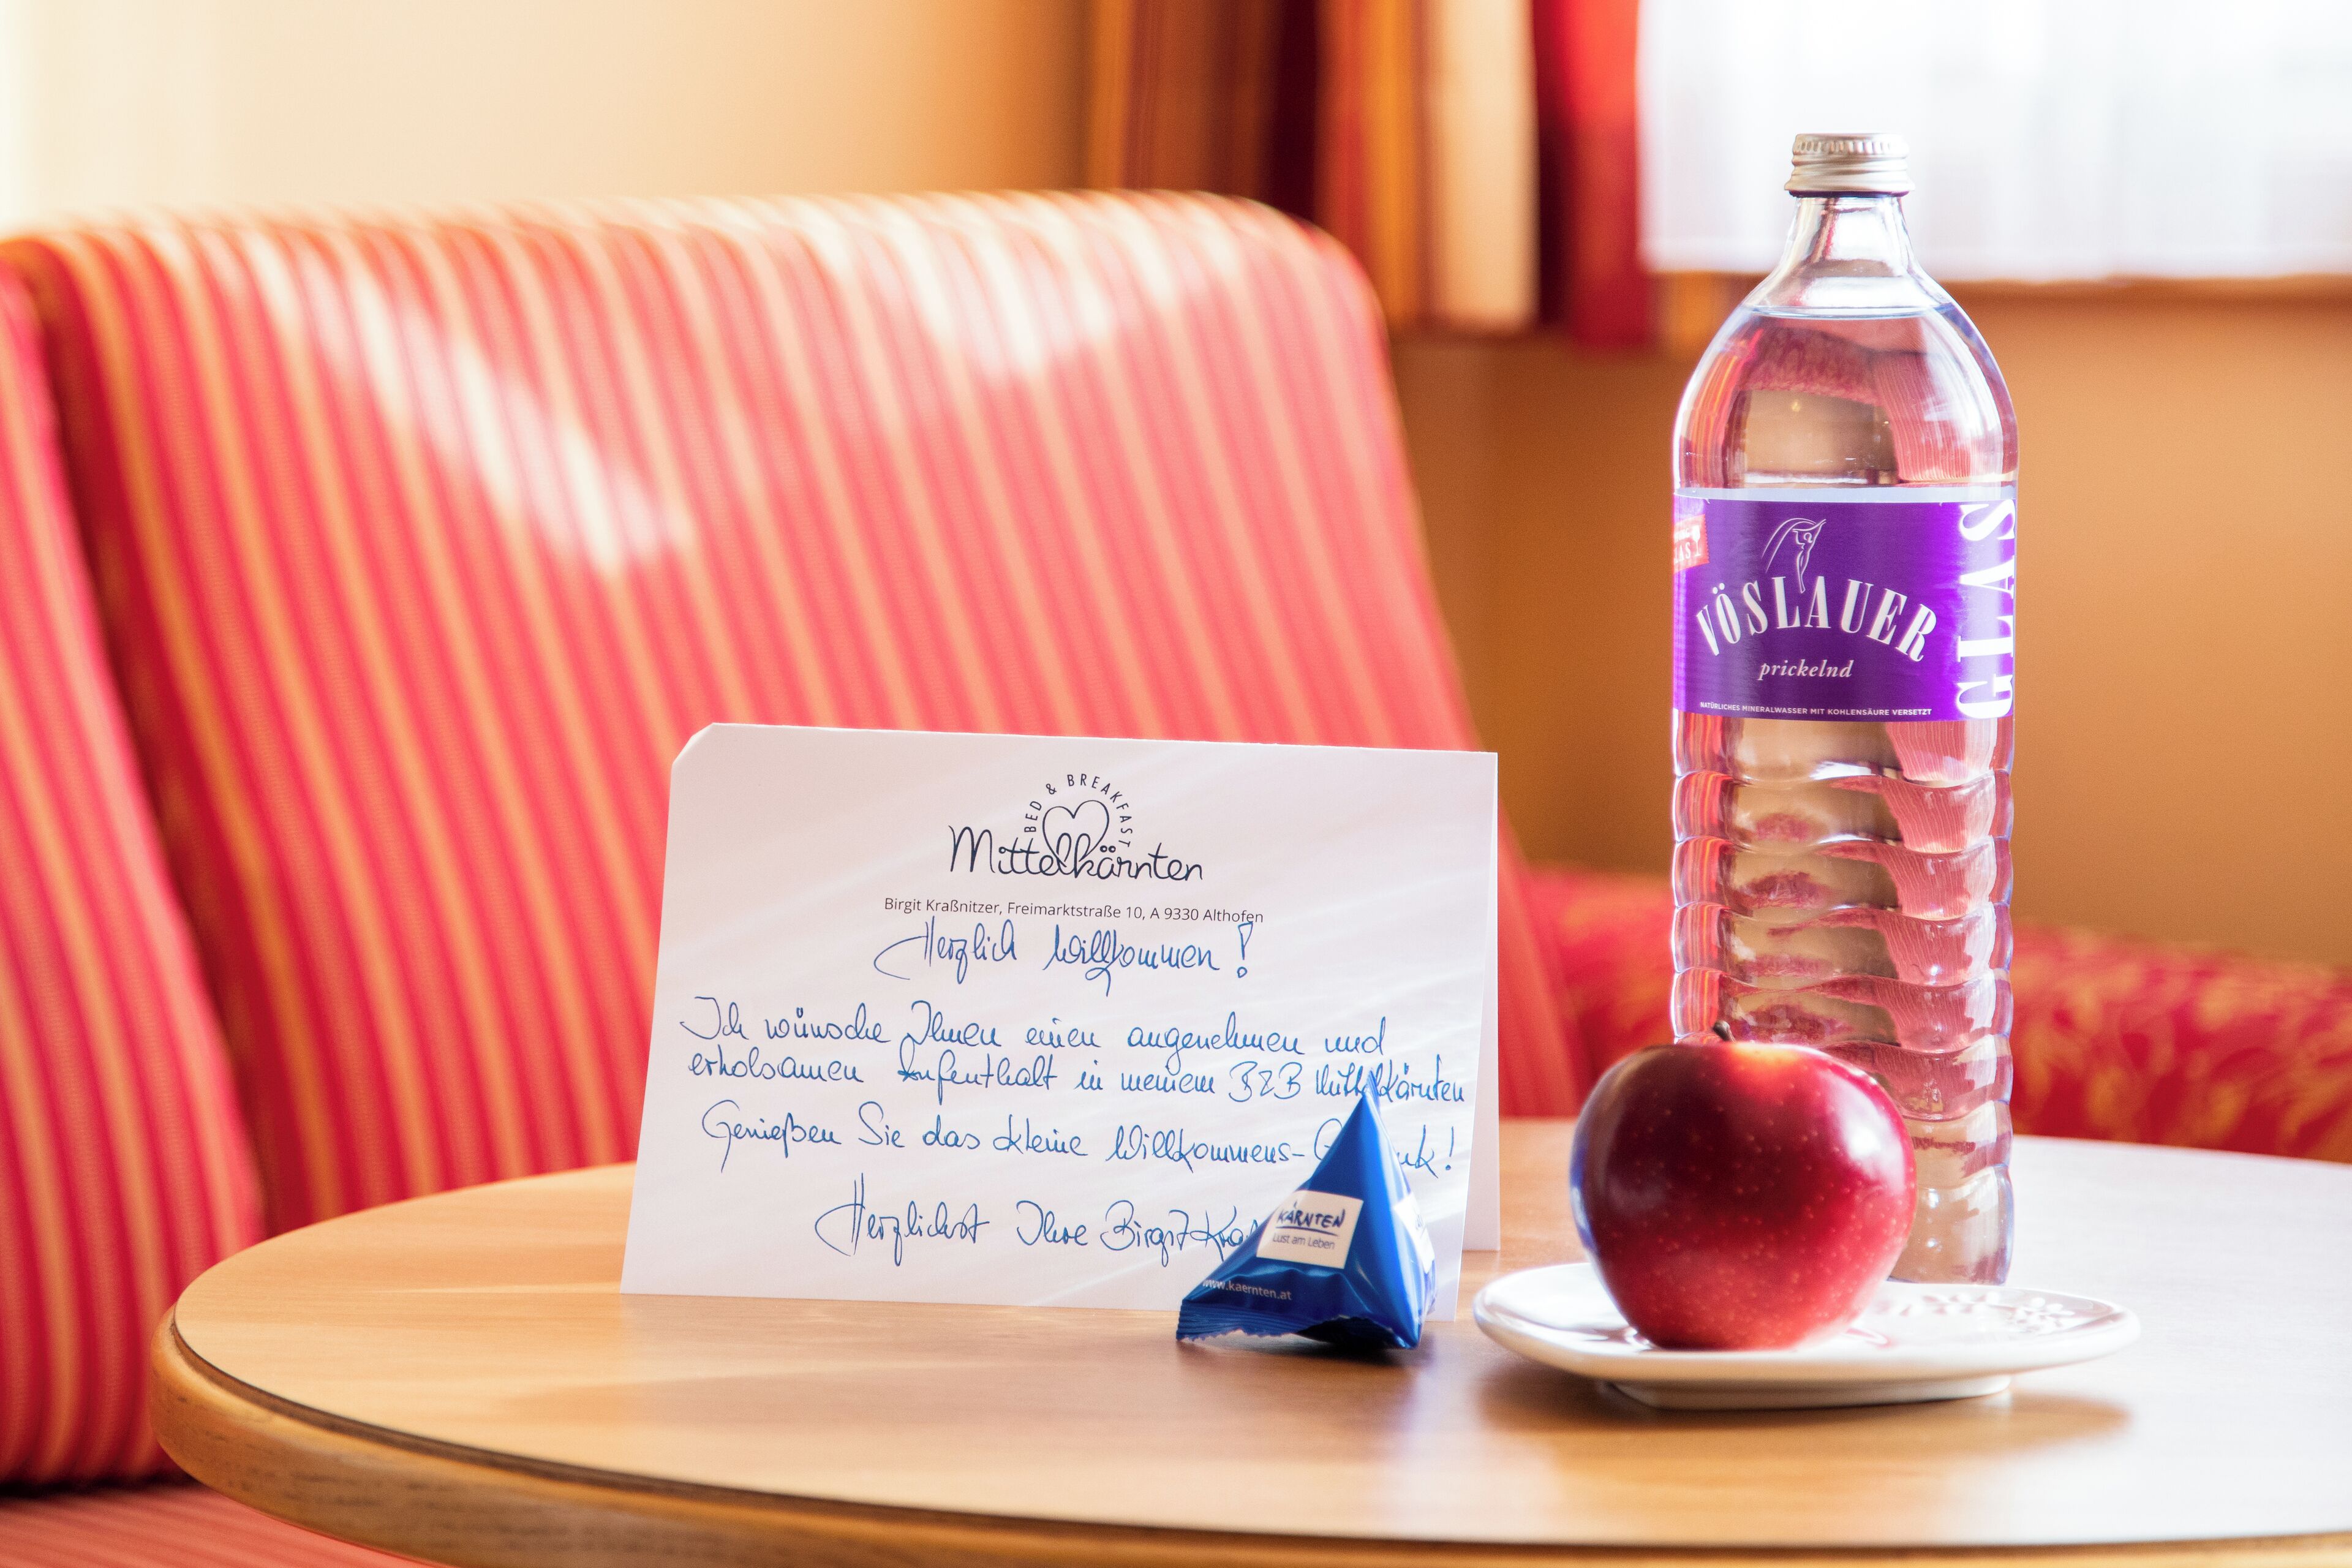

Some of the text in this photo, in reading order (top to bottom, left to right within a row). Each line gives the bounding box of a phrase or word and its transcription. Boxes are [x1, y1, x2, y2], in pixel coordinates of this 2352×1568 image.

[1695, 575, 1937, 663] VÖSLAUER
[1956, 499, 2016, 719] GLAS
[1757, 659, 1854, 681] prickelnd
[1700, 701, 1741, 712] NATÜRLICHES
[1742, 704, 1808, 715] MINERALWASSER
[1827, 707, 1890, 716] KOHLENSÄURE
[1023, 773, 1133, 848] BED & BREAKFAST
[948, 825, 1203, 881] Mittelkärnten
[884, 897, 1264, 924] Birgit Kraßnitzer, Freimarktstraße 10, A 9330 Althofen
[874, 916, 1017, 984] Herzlich
[680, 996, 1386, 1076] Ich wünsche Ihnen einen angenehmen und
[687, 1046, 865, 1083] erholsamen
[1073, 1059, 1103, 1091] in
[1121, 1070, 1216, 1095] meinem
[702, 1099, 842, 1174] Genießen
[858, 1101, 905, 1148] Sie
[922, 1114, 981, 1150] das
[815, 1172, 990, 1267] Herzlichst
[1015, 1199, 1089, 1246] Ihre
[1272, 1232, 1336, 1250] Lust am Leben
[1202, 1278, 1293, 1301] www.kaernten.at
